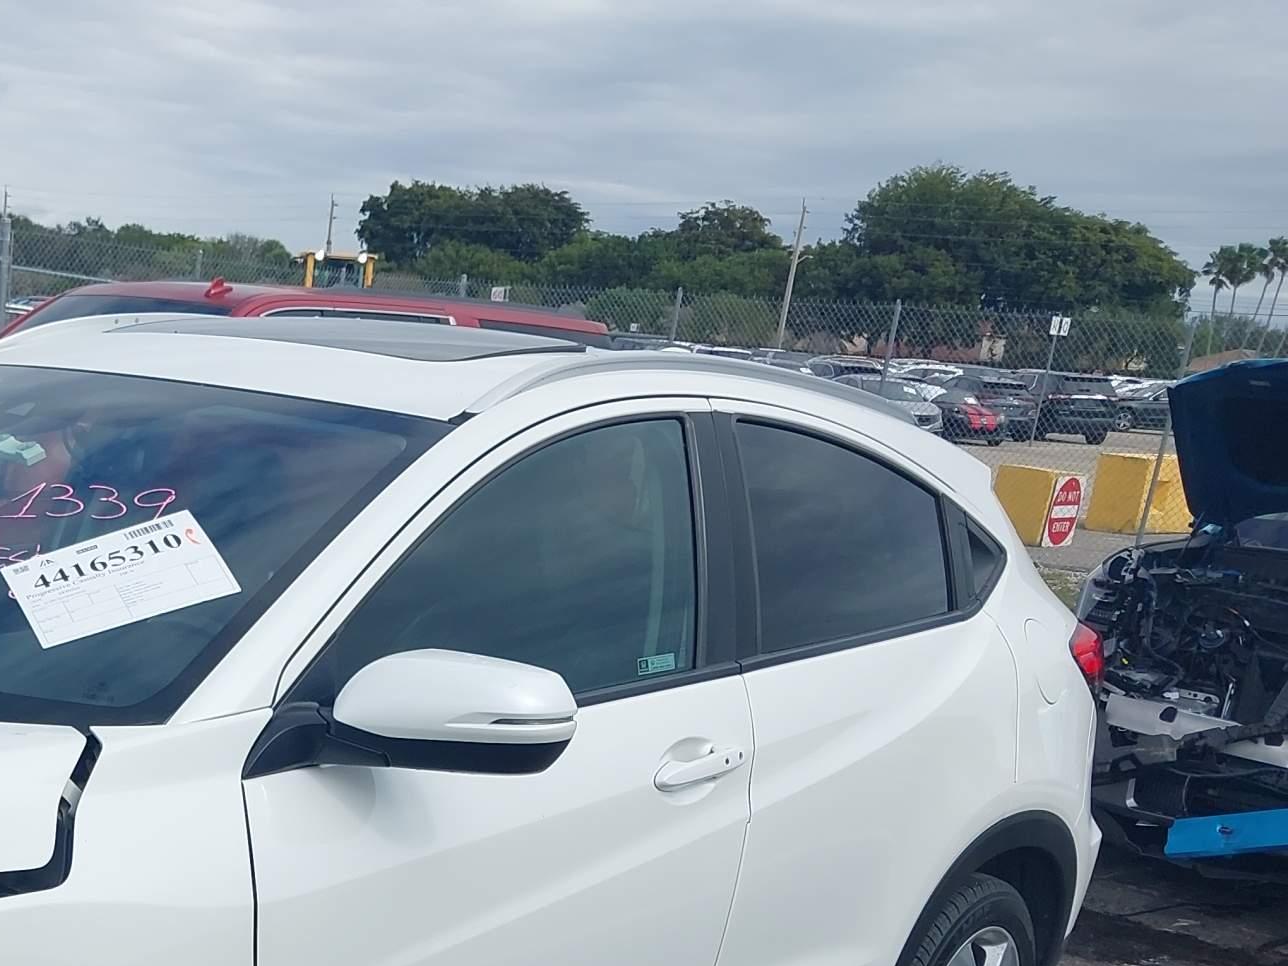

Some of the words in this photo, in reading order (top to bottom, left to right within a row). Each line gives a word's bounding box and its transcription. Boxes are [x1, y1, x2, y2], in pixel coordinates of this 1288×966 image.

[1057, 491, 1067, 502] DO
[1067, 491, 1080, 502] NOT
[1052, 521, 1070, 532] ENTER
[33, 533, 182, 590] 44165310
